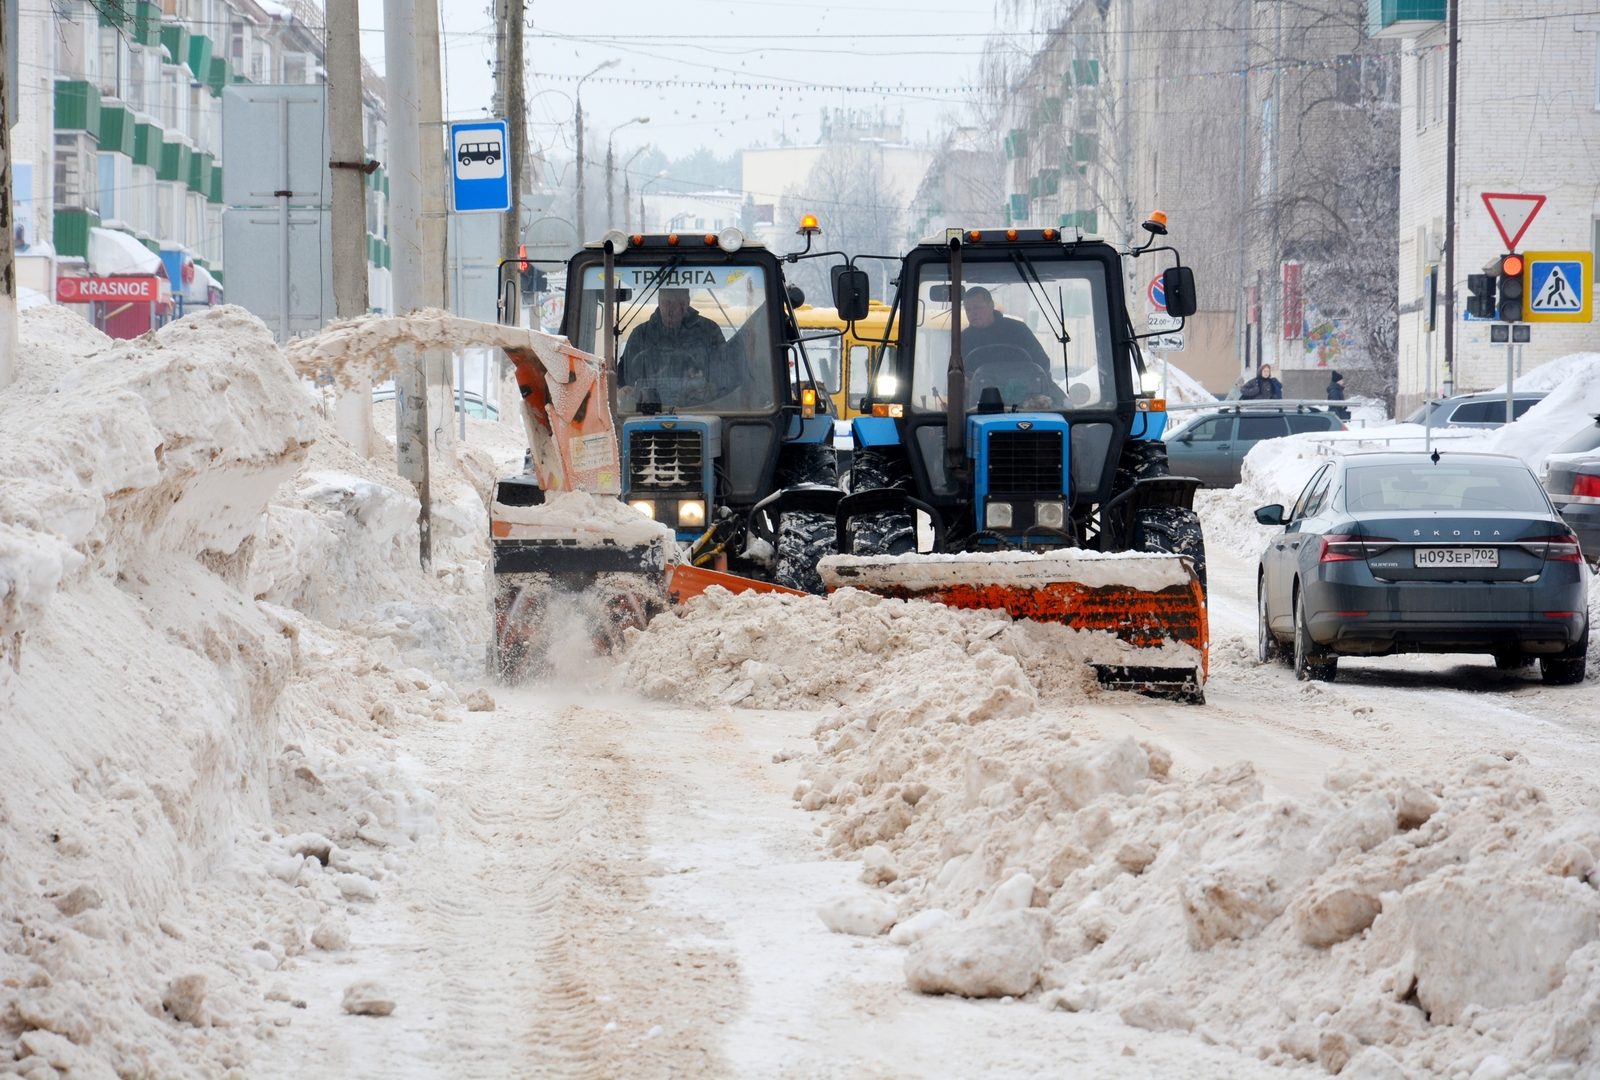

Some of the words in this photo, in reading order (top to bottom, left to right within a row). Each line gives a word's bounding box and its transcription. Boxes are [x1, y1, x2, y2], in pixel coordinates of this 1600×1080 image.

[632, 270, 716, 286] ТРУДЯГА
[80, 281, 149, 296] KRASNOE
[1419, 550, 1472, 563] Н093ЕР
[1474, 550, 1495, 560] 702
